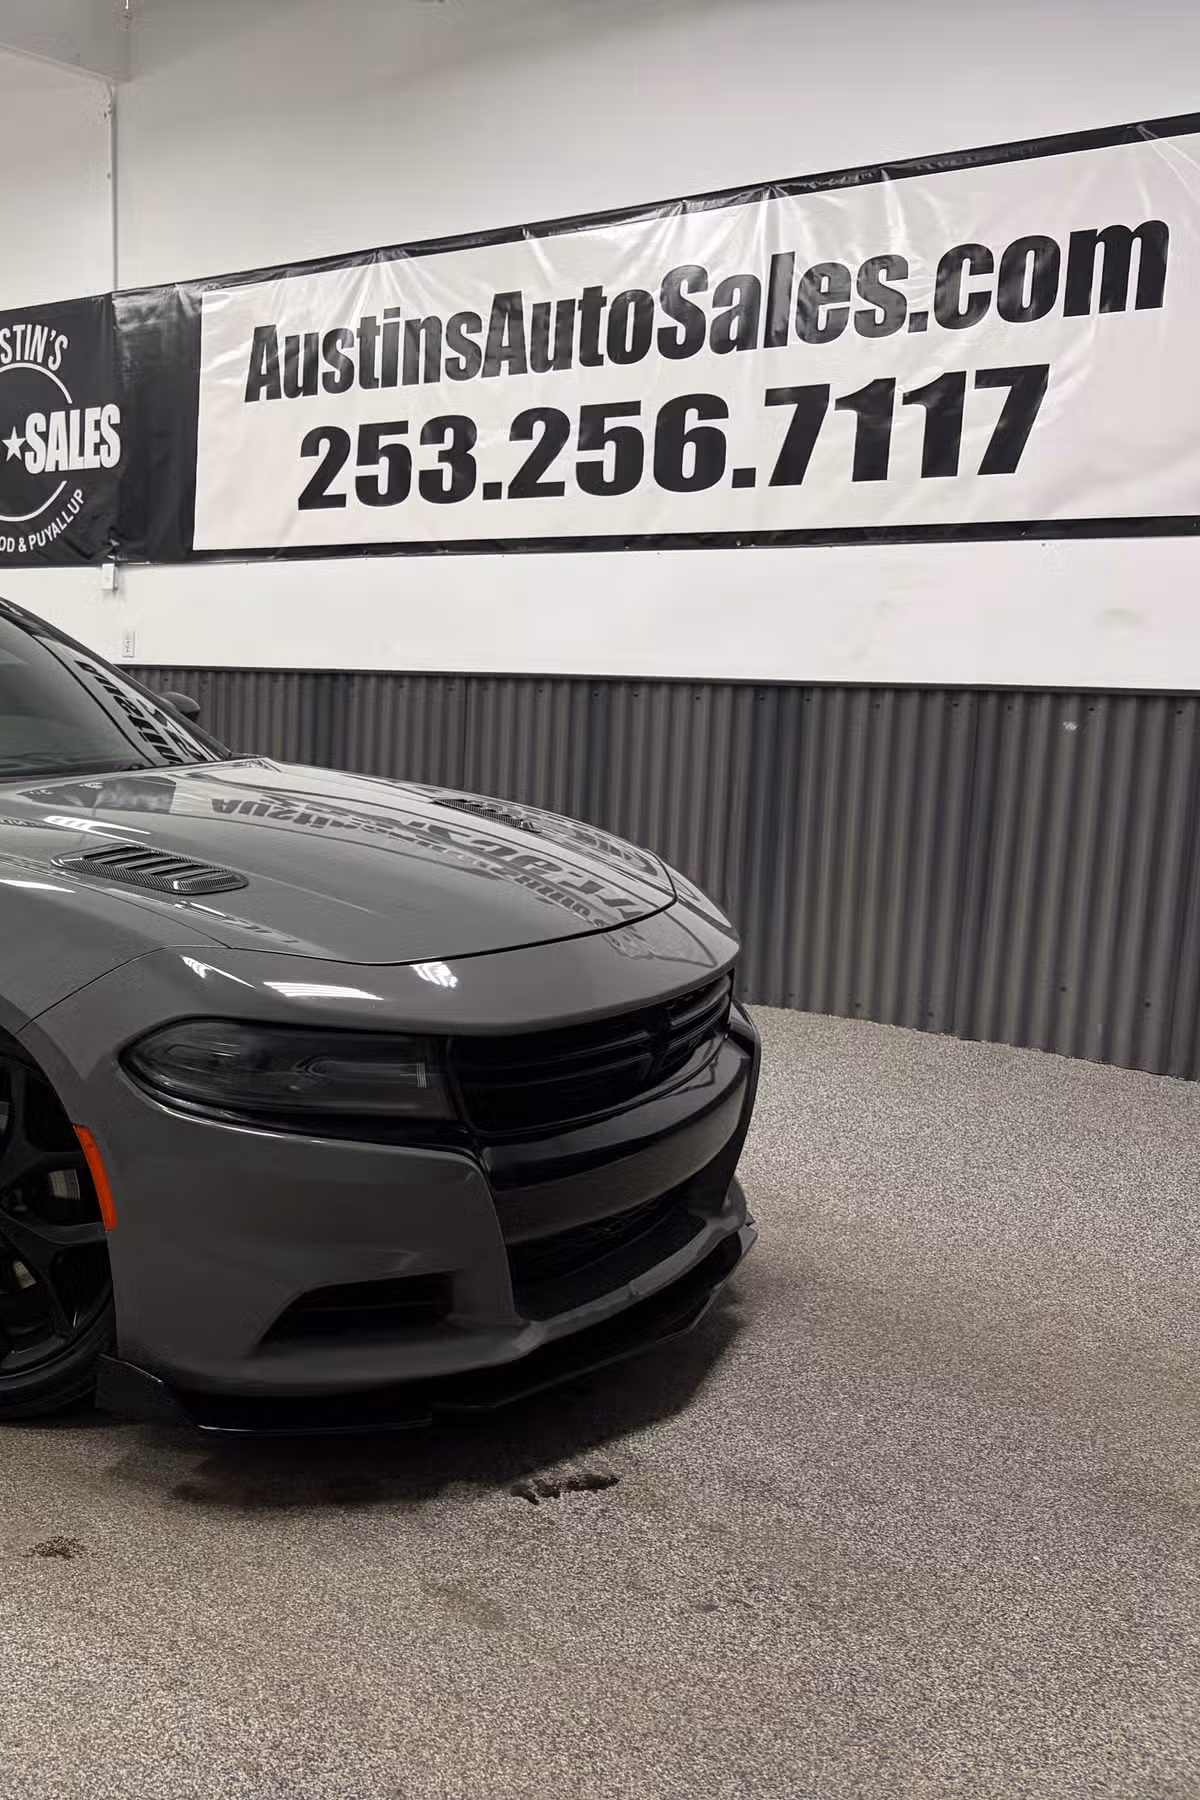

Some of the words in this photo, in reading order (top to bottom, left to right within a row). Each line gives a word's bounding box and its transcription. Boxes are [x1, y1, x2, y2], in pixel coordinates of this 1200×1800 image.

[244, 219, 1170, 403] AustinsAutoSales.com
[24, 403, 121, 475] SALES
[298, 364, 1051, 511] 253.256.7117
[18, 537, 27, 552] &
[28, 488, 84, 550] PUYALLUP
